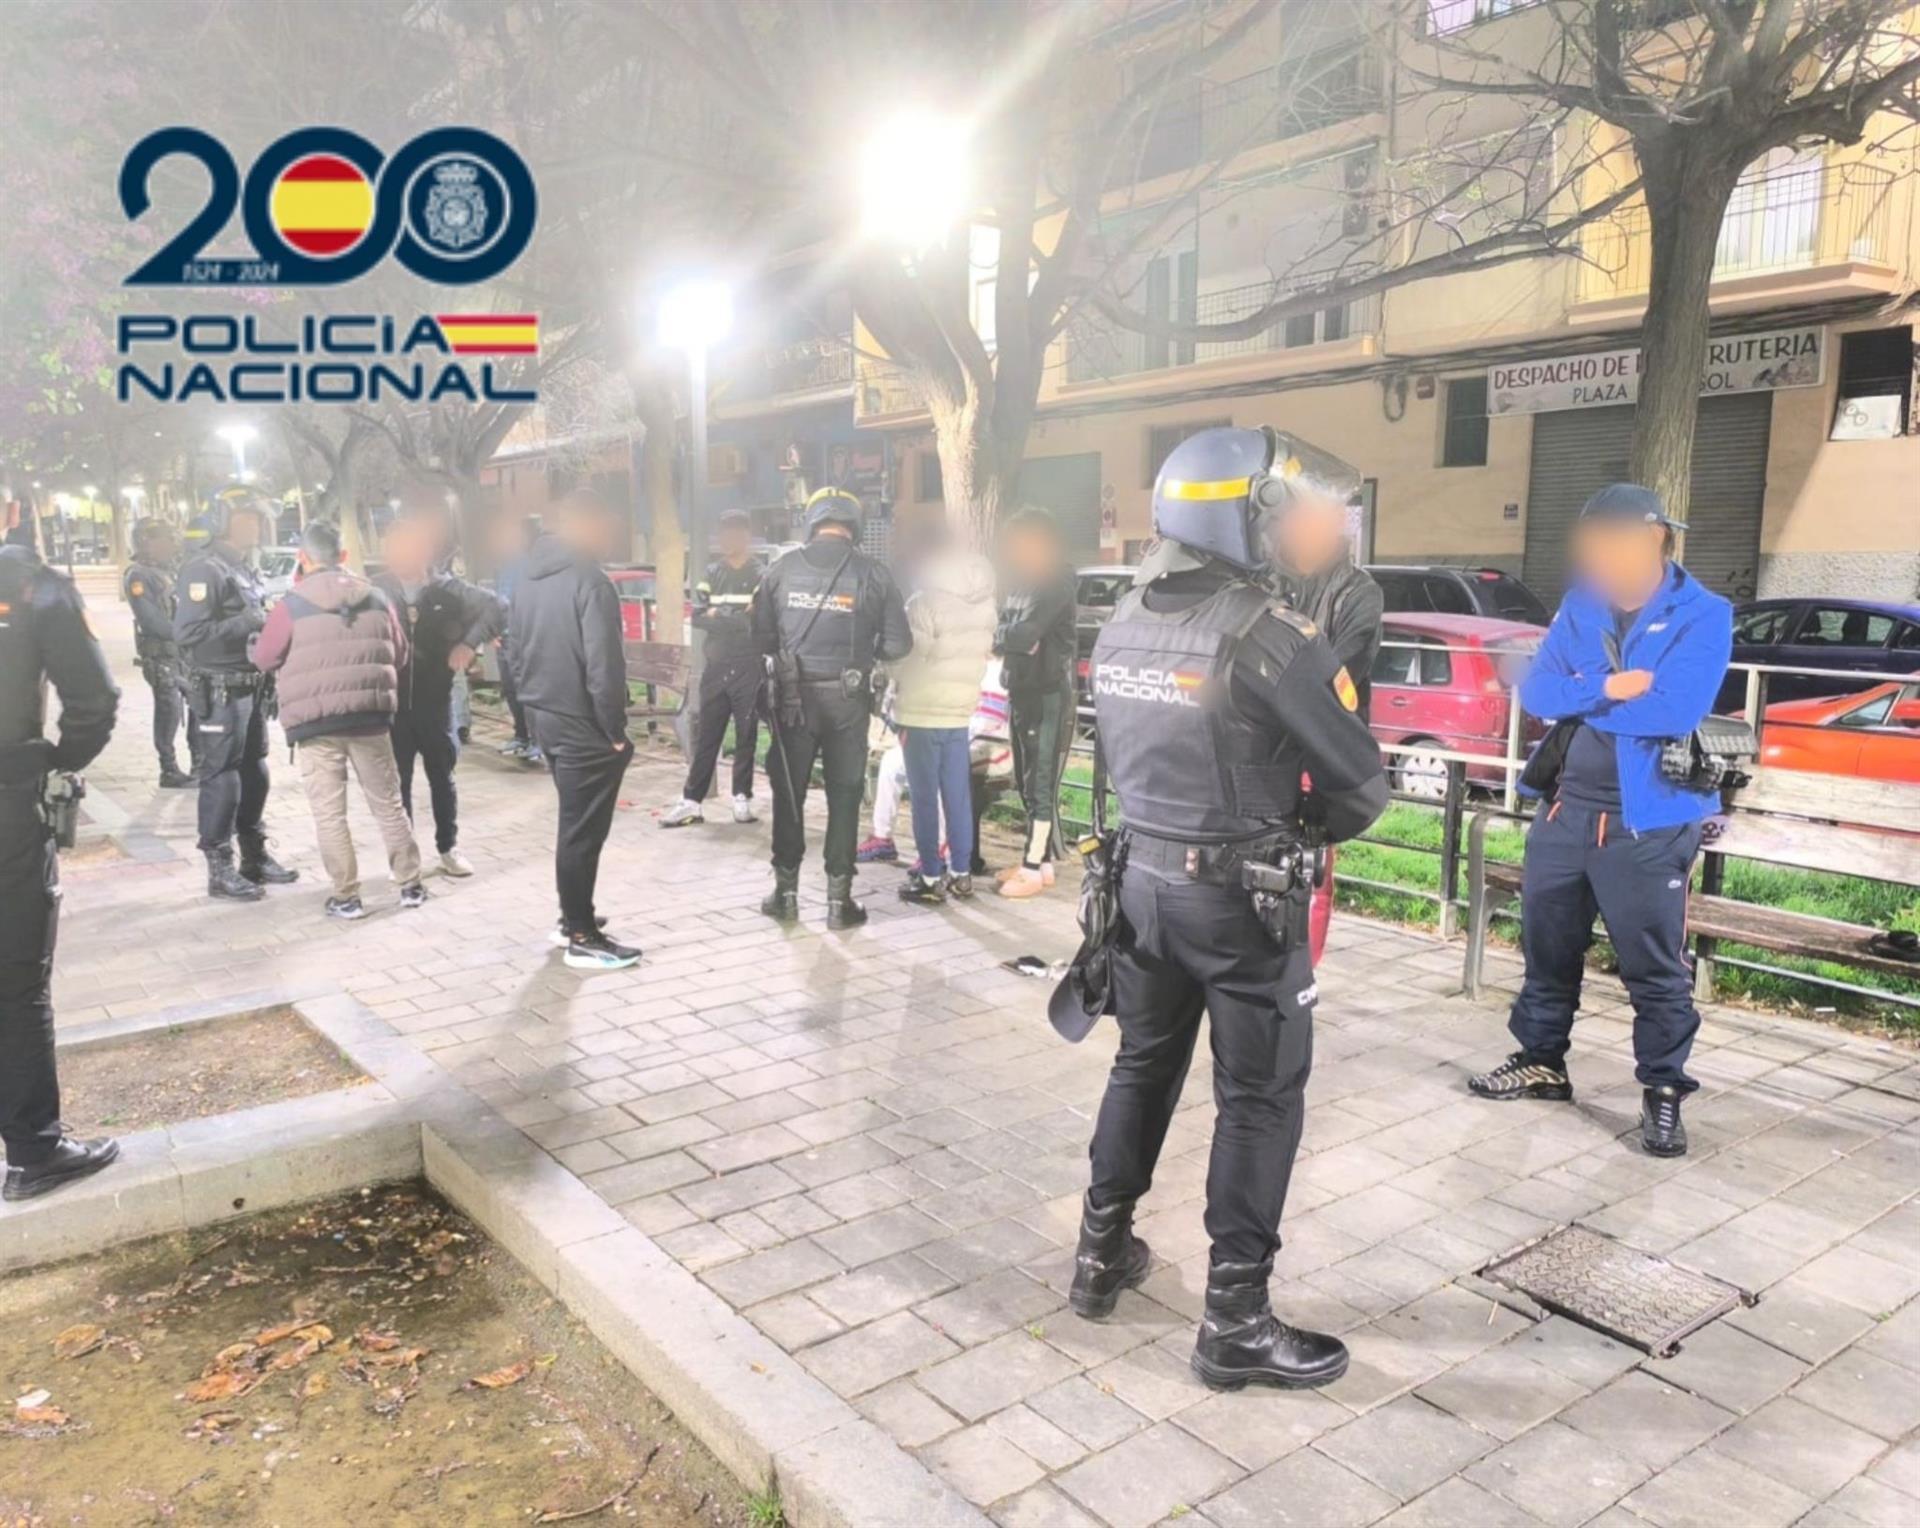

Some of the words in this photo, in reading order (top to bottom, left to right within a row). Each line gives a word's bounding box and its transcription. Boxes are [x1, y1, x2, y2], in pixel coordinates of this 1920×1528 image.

[1494, 359, 1597, 390] DESPACHO
[1603, 355, 1630, 377] DE
[1709, 333, 1817, 365] RUTERIA
[1572, 384, 1627, 404] PLAZA
[1096, 664, 1178, 687] POLICIA
[1096, 680, 1201, 707] NACIONAL
